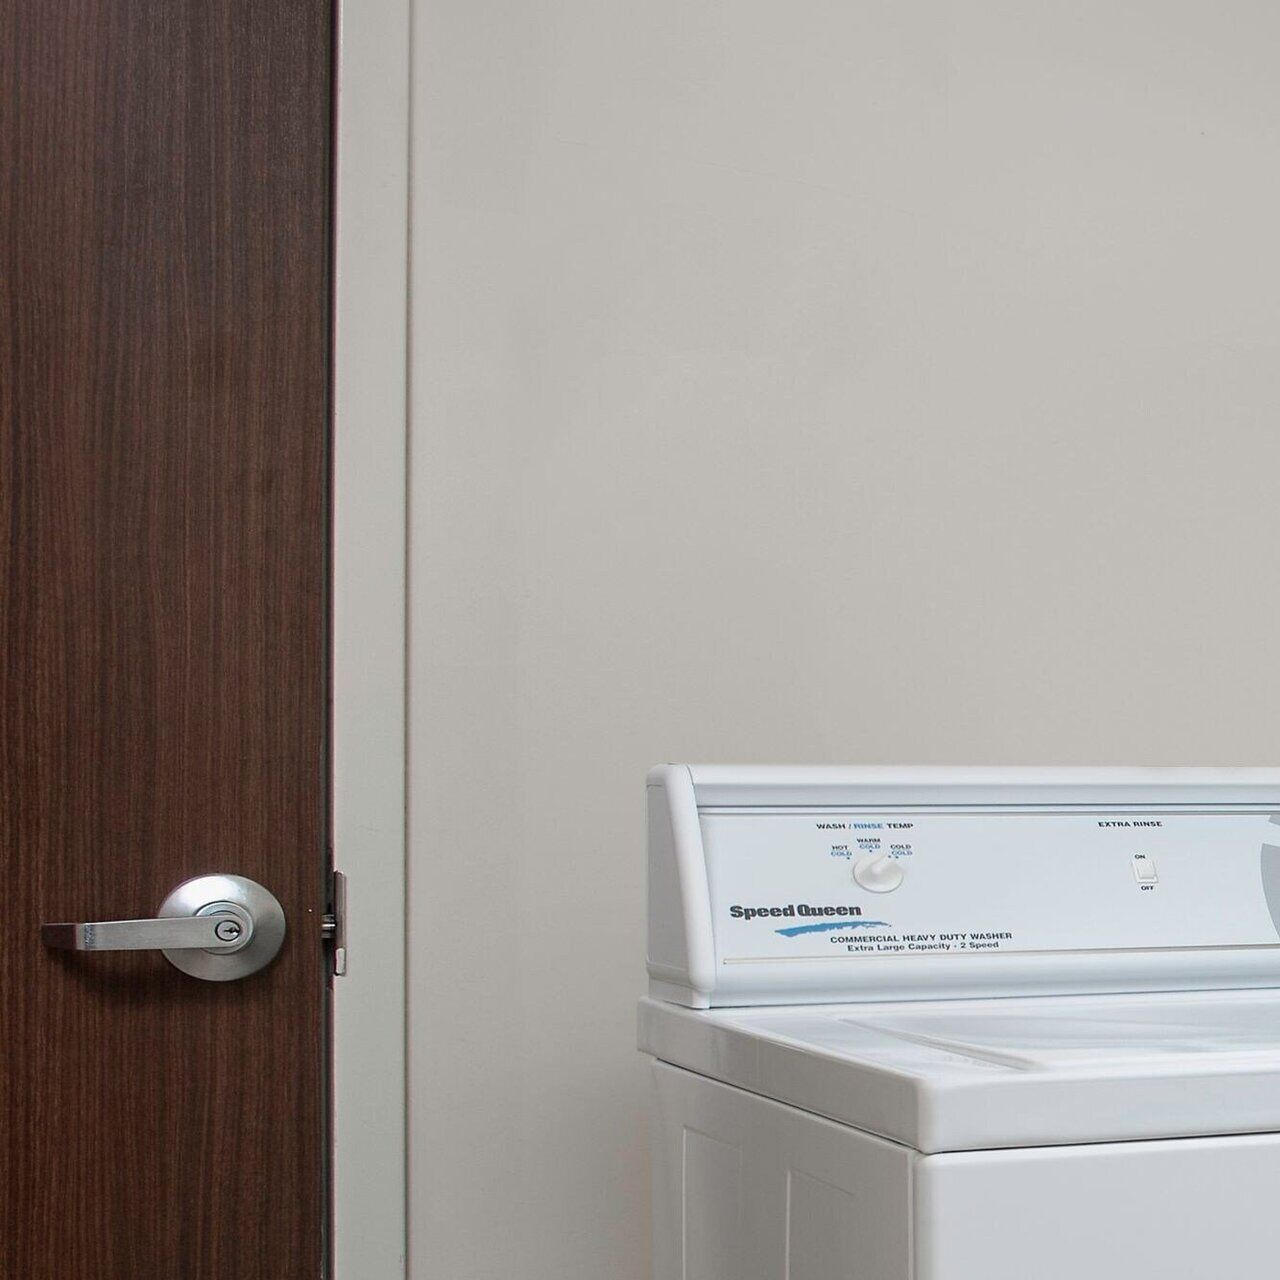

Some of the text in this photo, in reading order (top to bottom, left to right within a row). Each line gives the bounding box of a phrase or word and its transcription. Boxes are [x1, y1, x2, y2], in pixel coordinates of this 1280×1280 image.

[852, 822, 885, 830] RINSE
[729, 904, 862, 921] Speed Queen
[830, 932, 1013, 944] COMMERCIAL HEAVY DUTY WASHER
[847, 944, 874, 952] Extra
[876, 943, 906, 952] Large
[908, 942, 951, 951] Capacity
[968, 941, 1000, 950] Speed
